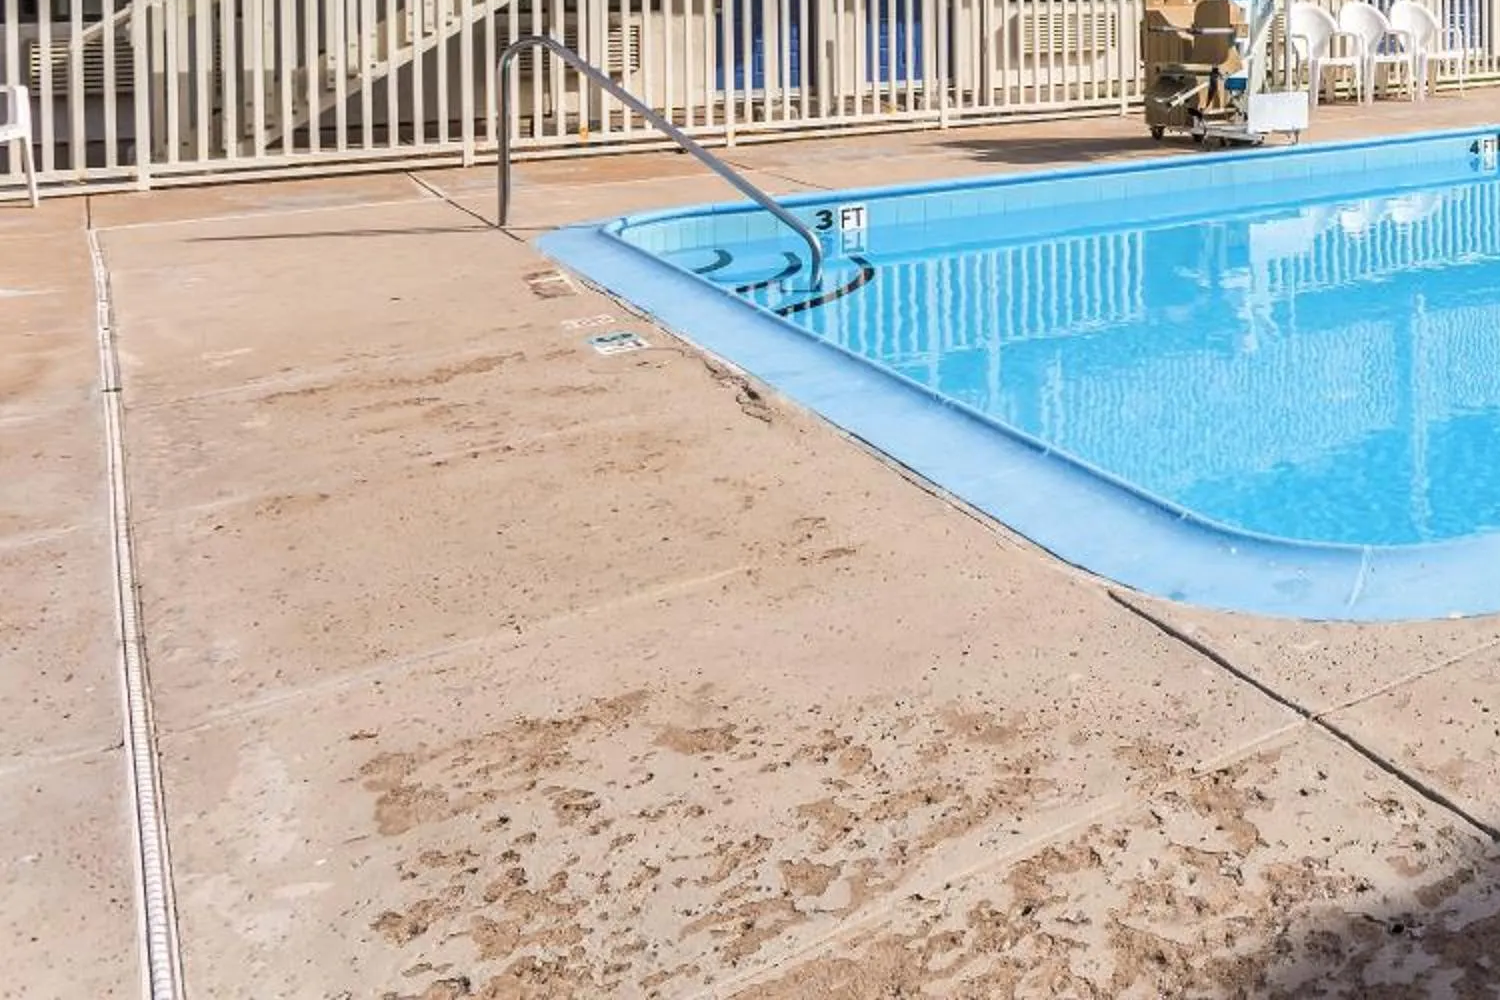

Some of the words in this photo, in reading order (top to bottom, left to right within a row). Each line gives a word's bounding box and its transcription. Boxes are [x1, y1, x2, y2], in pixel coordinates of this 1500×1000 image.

[1469, 140, 1479, 154] 4
[815, 209, 833, 230] 3
[841, 207, 864, 228] FT
